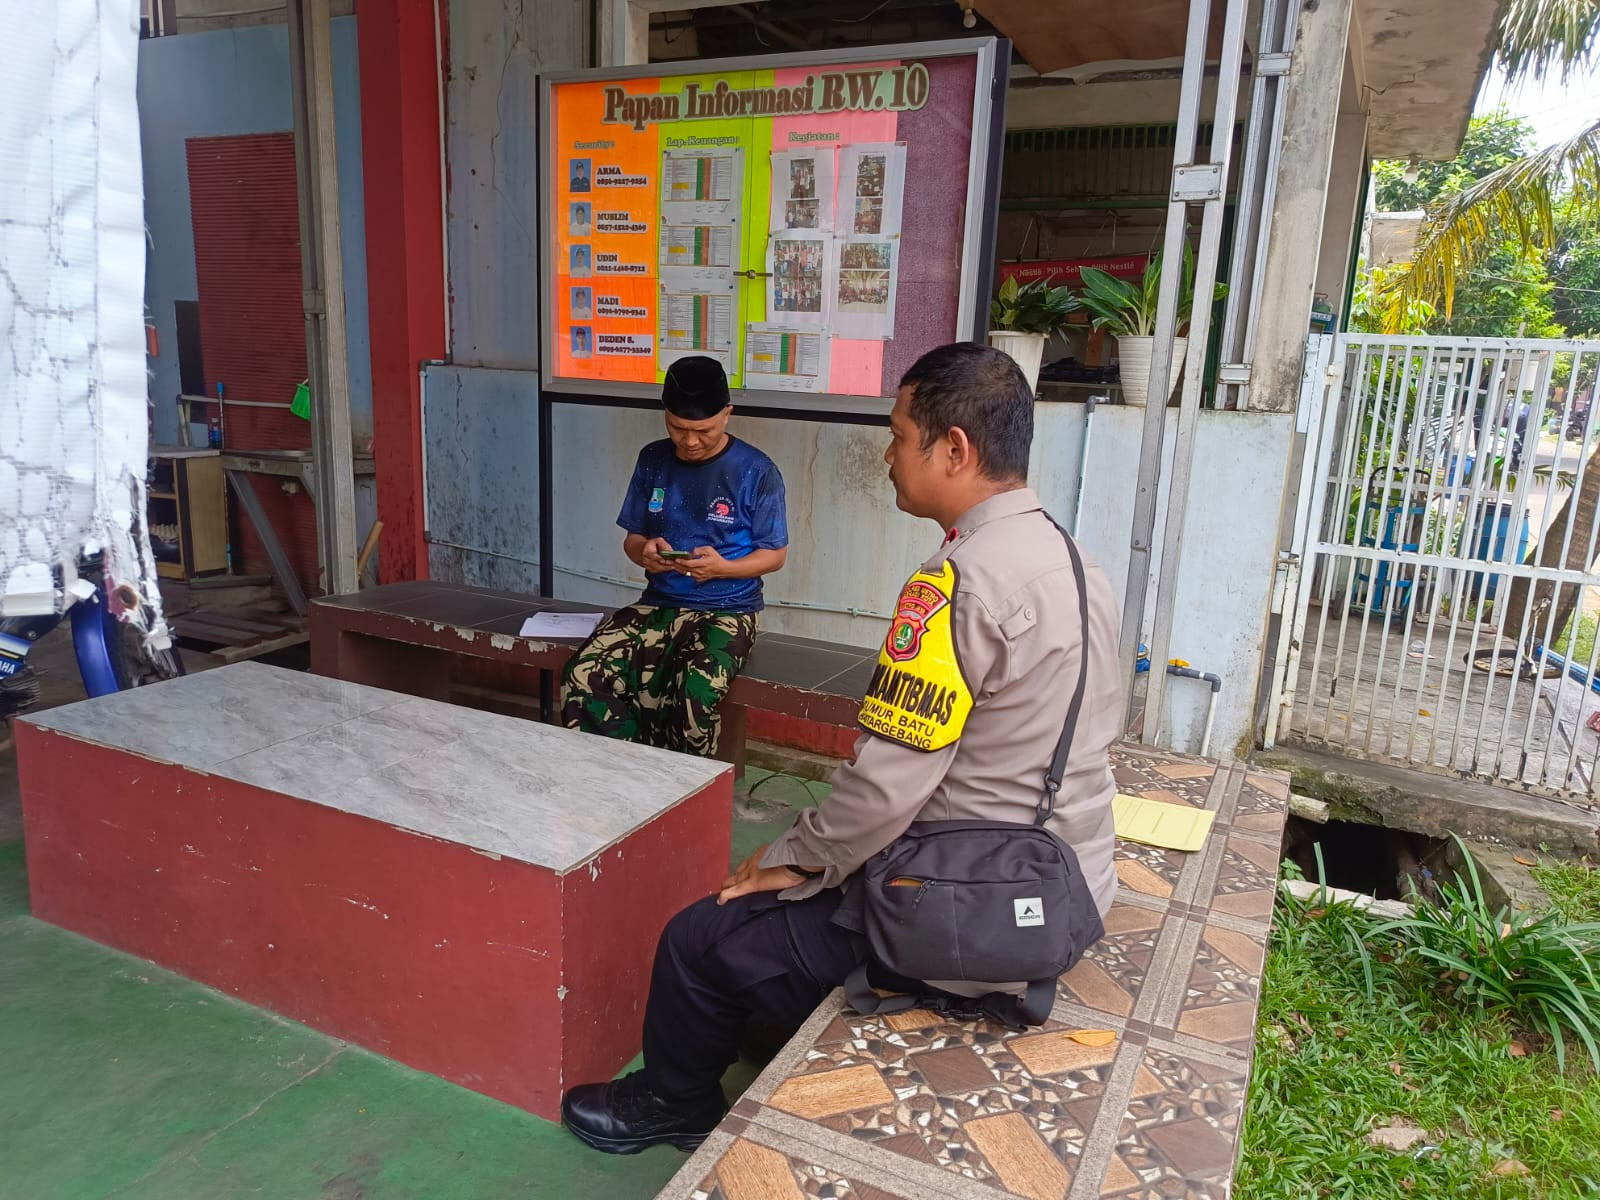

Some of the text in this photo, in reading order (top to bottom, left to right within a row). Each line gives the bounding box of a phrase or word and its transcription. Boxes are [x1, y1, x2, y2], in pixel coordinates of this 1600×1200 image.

[602, 87, 680, 131] Papan
[683, 75, 814, 118] Informasi
[667, 137, 686, 148] Lap.
[597, 167, 622, 175] ARMA
[597, 213, 629, 221] MUSLIM
[597, 254, 618, 262] UDIN
[1047, 266, 1064, 274] Pilih
[597, 297, 619, 306] MADI
[598, 335, 626, 344] DEDEN
[898, 715, 935, 737] BATU
